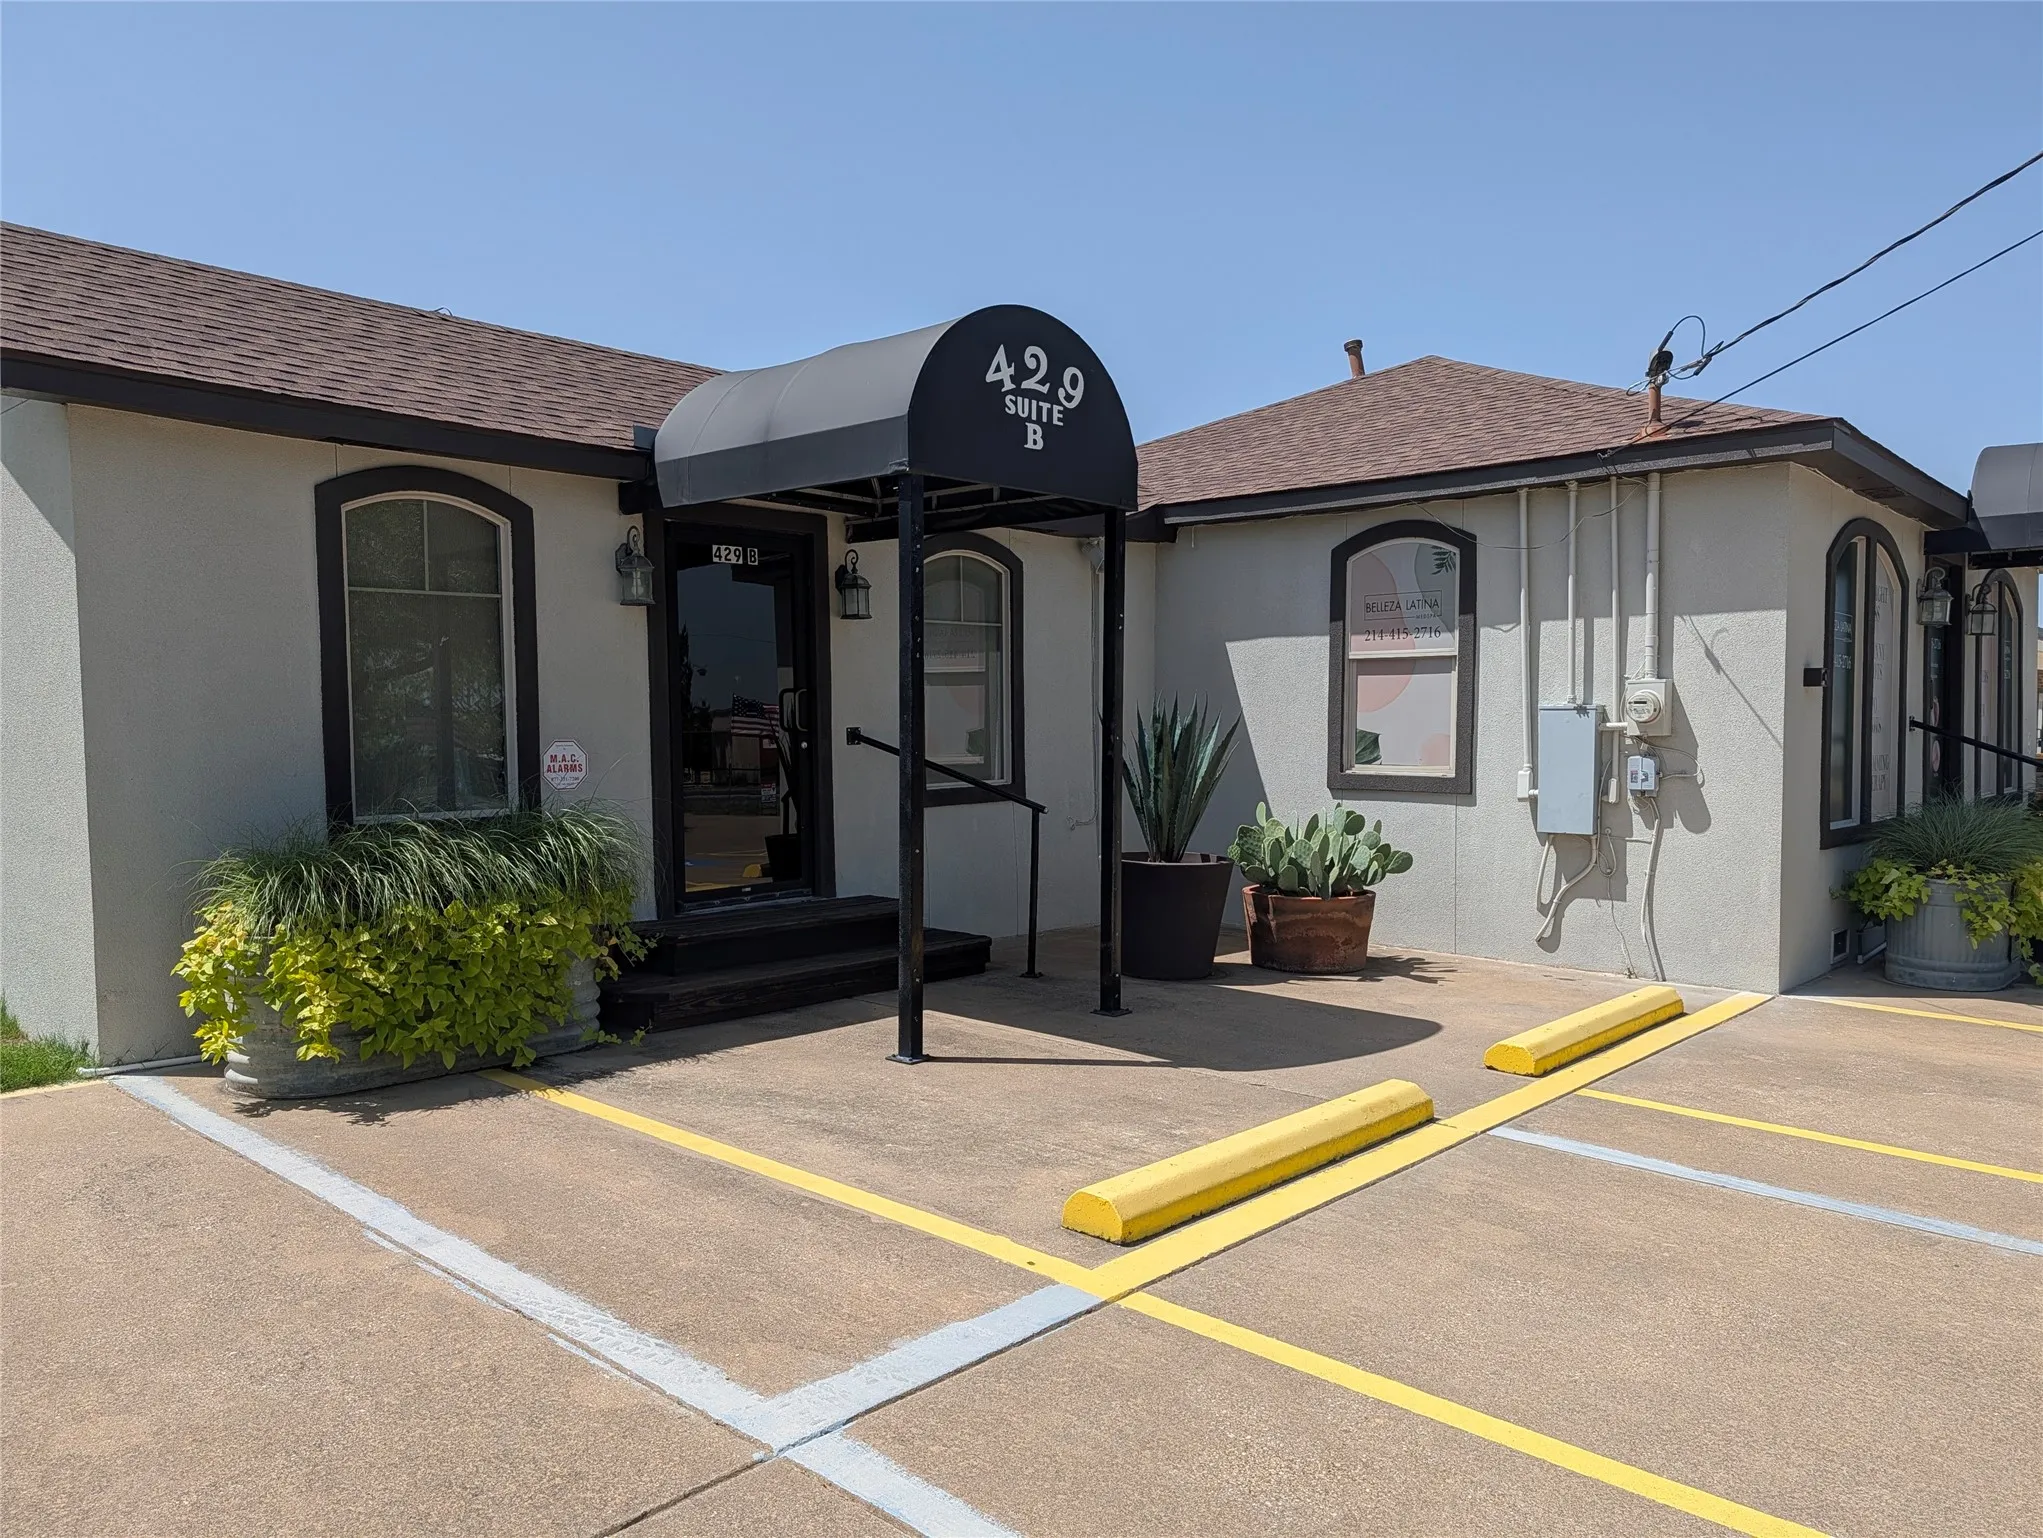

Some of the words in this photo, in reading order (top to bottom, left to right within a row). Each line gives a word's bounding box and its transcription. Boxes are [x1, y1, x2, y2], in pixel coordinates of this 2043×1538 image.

[985, 343, 1085, 409] 429
[1004, 394, 1064, 426] SUITE
[1023, 421, 1044, 450] B
[713, 546, 742, 562] 429
[749, 548, 757, 563] B
[1365, 600, 1402, 613] BELLEZA
[1405, 598, 1440, 611] LATINA
[1364, 626, 1442, 641] 214-415-2716
[550, 753, 579, 763] M.A.C.
[546, 763, 583, 774] ALARMS
